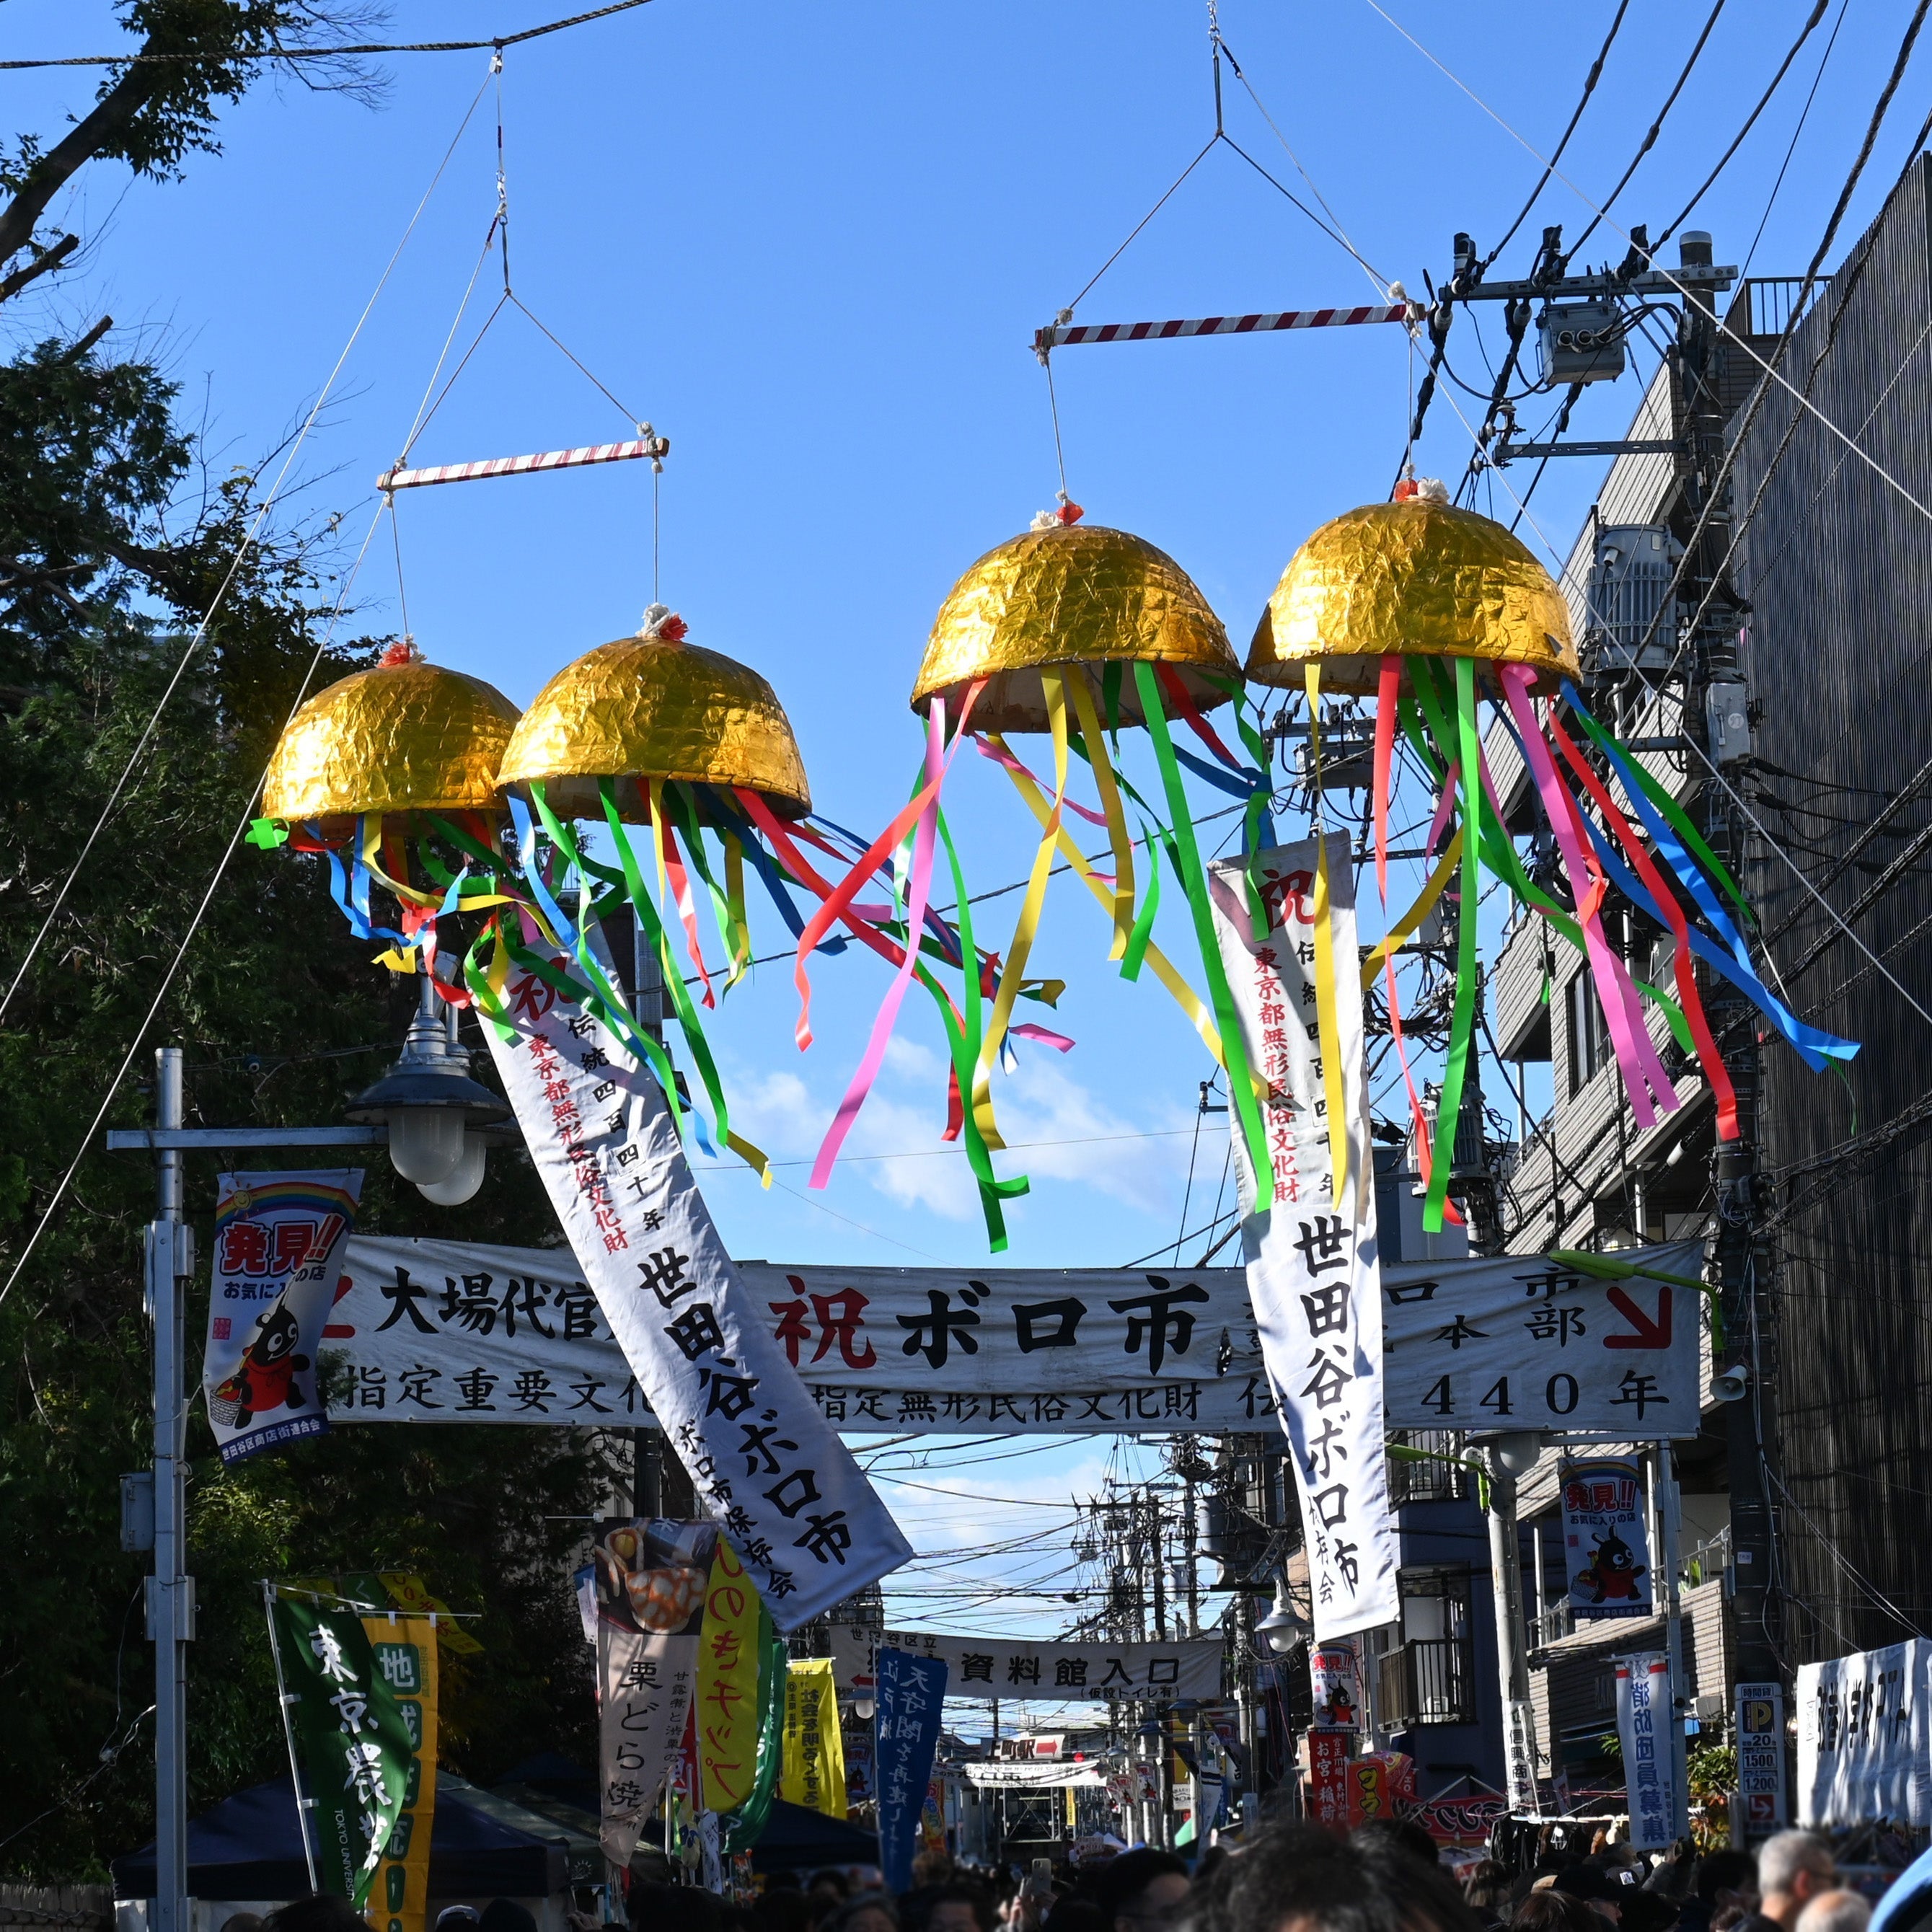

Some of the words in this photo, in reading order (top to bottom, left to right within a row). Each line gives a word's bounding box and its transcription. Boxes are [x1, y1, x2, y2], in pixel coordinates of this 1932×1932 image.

[1251, 868, 1314, 932] 祝
[509, 956, 575, 1021] 祝
[1253, 947, 1300, 1203] 東京都無形民俗文化財
[527, 1033, 629, 1256] 東京都無形民俗文化財
[568, 1015, 665, 1232] 伝統四百四十年
[221, 1418, 321, 1462] 世田谷区商店街連合会
[638, 1246, 852, 1566] 世田谷ボロ市
[1292, 1214, 1354, 1600] 世田谷ボロ市
[679, 1419, 798, 1599] ボロ市保存会
[1570, 1513, 1636, 1526] お気に入りの店
[1752, 1735, 1770, 1746] 20
[1316, 1742, 1336, 1822] お宮・稲荷
[335, 1809, 348, 1845] TOKYO
